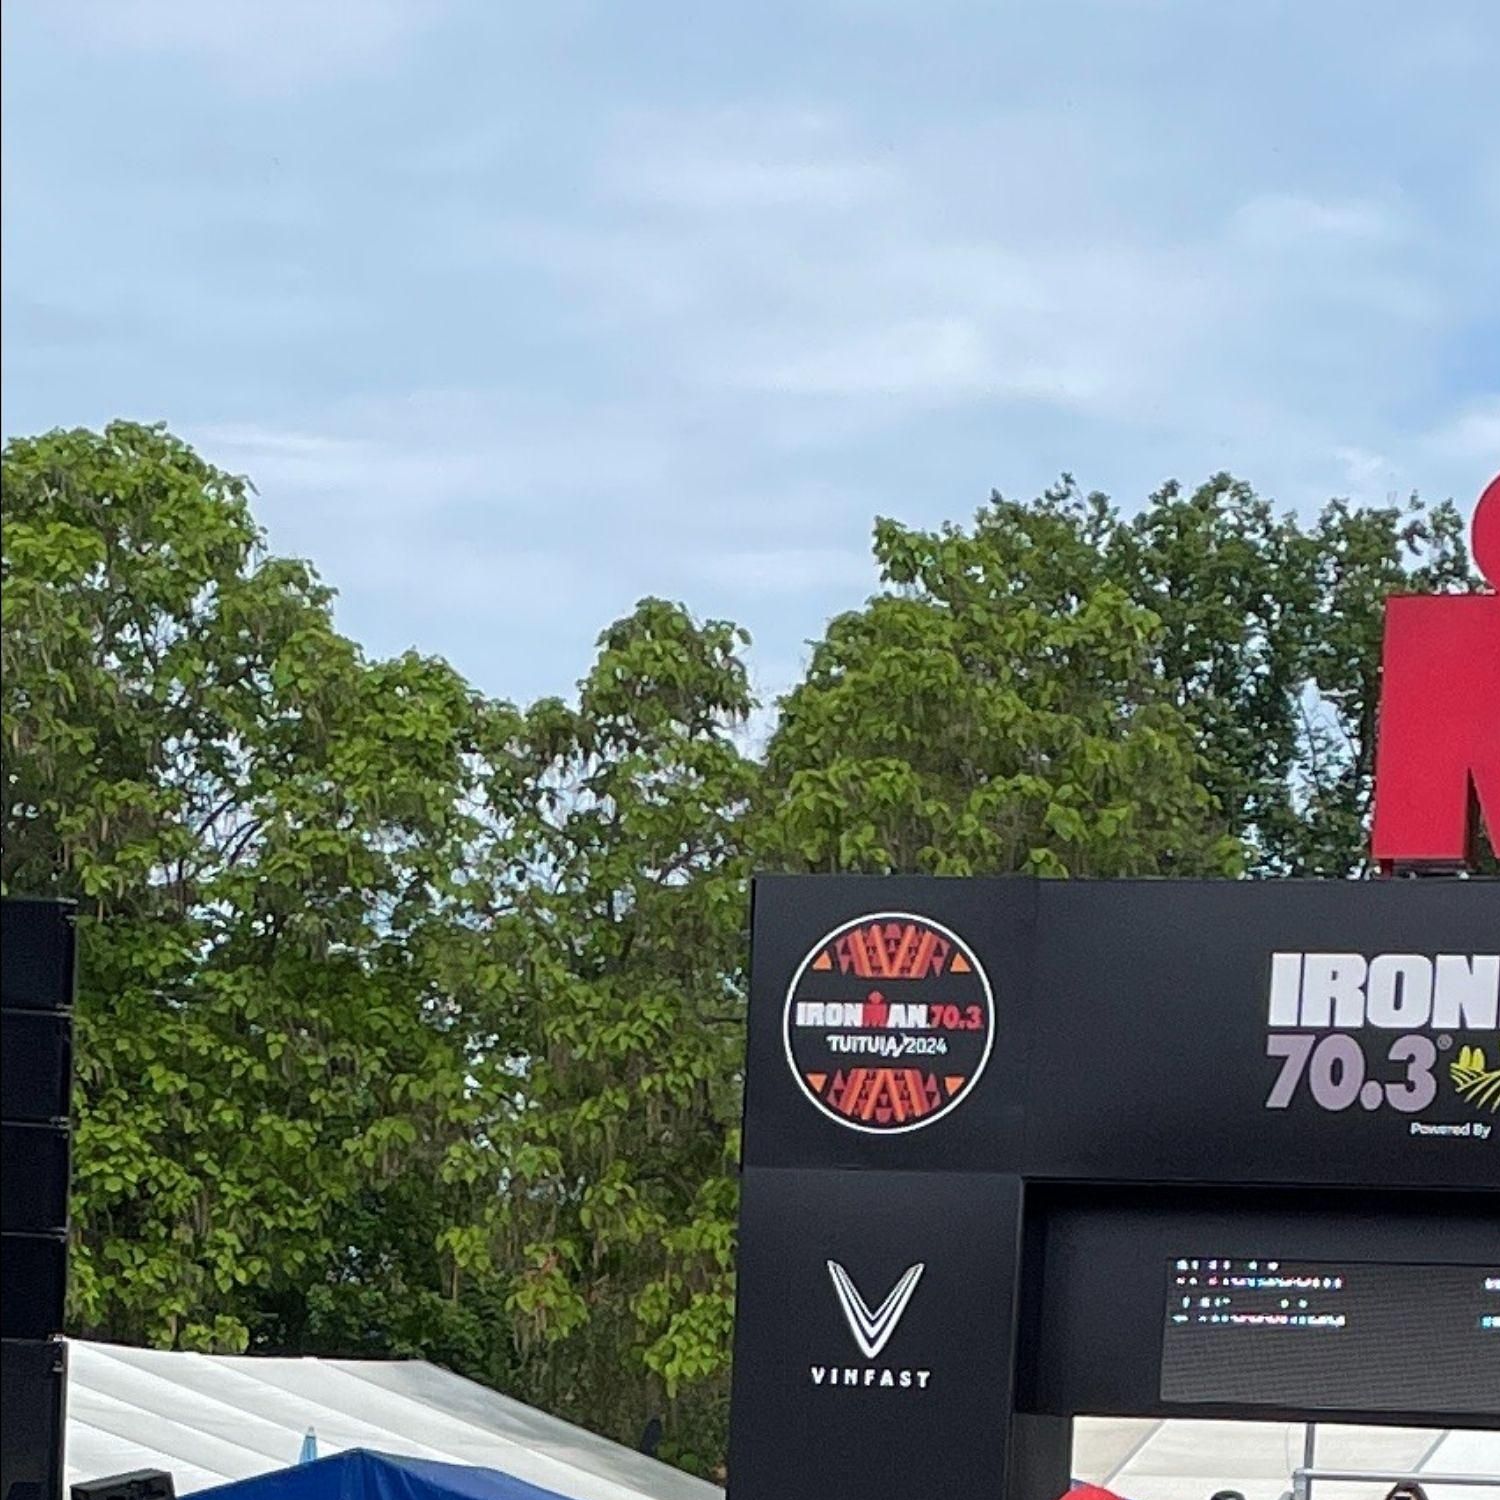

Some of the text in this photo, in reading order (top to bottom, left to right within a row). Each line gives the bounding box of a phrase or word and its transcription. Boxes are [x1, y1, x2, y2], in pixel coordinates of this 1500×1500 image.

[796, 991, 983, 1030] IRONMAN 70.3
[1265, 1034, 1437, 1112] 70.3
[1410, 1122, 1491, 1138] Powered By
[811, 1366, 930, 1388] VINFAST
